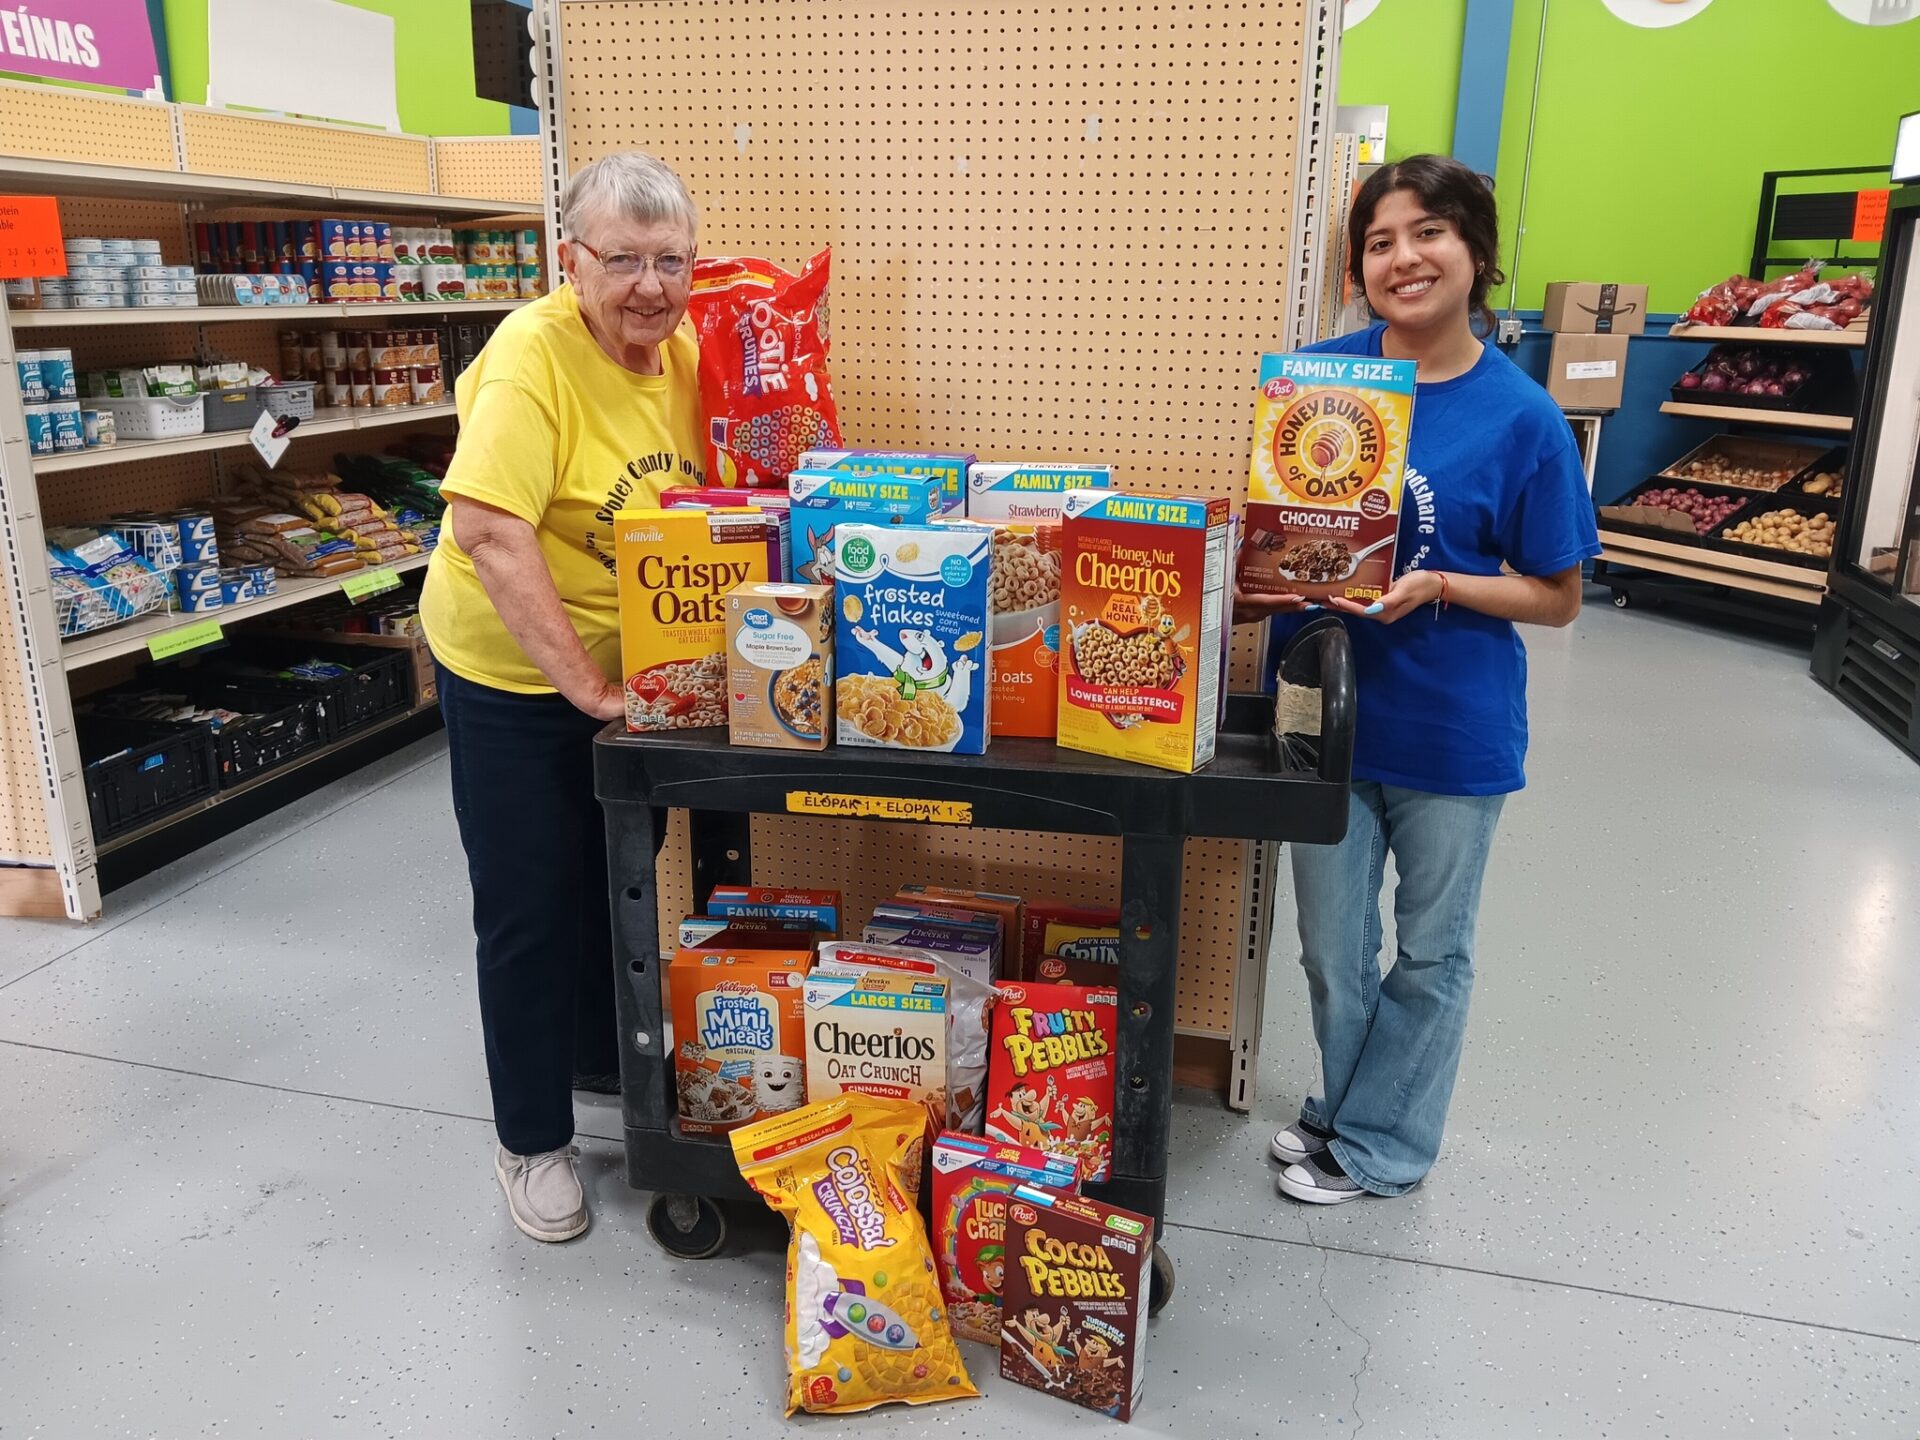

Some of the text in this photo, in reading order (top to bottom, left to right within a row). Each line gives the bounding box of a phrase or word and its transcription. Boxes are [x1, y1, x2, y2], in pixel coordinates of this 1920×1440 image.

[0, 5, 100, 68] EÍNAS
[1282, 360, 1394, 380] FAMILY SIZE
[1267, 381, 1291, 396] Post
[1280, 397, 1377, 463] HONEY BUNCHES
[1289, 466, 1306, 481] of
[1014, 474, 1093, 490] FAMILY SIZE
[1305, 470, 1363, 497] OATS
[829, 481, 908, 500] FAMILY SIZE
[889, 504, 898, 512] 12
[1008, 504, 1061, 519] Strawberry
[1106, 500, 1188, 523] FAMILY SIZE
[1208, 511, 1228, 526] Cheerios
[1279, 510, 1360, 530] CHOCOLATE
[712, 525, 721, 534] NO
[624, 532, 664, 543] Millville
[847, 543, 869, 554] food
[1112, 545, 1148, 566] Honey
[1152, 549, 1175, 566] Nut
[849, 554, 868, 564] club
[637, 555, 751, 595] Crispy
[1076, 552, 1181, 597] Cheerios
[732, 598, 739, 608] 8
[864, 584, 945, 608] frosted
[652, 591, 725, 624] Oats
[870, 604, 934, 626] flakes
[1112, 603, 1137, 614] REAL
[747, 612, 768, 621] Great
[935, 609, 981, 625] sweetened
[939, 618, 958, 628] corn
[1106, 611, 1142, 625] HONEY
[662, 627, 726, 638] TOASTED WHOLE GRAIN
[752, 632, 794, 641] Sugar Free
[935, 625, 961, 636] cereal
[679, 635, 711, 644] OAT CEREAL
[746, 643, 765, 651] Maple
[1002, 670, 1033, 684] oats
[1003, 694, 1025, 704] honey
[1071, 687, 1177, 711] LOWER CHOLESTEROL
[1120, 688, 1139, 696] HELP
[804, 796, 858, 809] ELOPAK
[886, 802, 941, 815] ELOPAK
[948, 806, 953, 816] 1
[726, 907, 818, 918] FAMILY SIZE
[729, 922, 768, 930] Cheerios
[1032, 919, 1039, 929] 8
[911, 928, 950, 940] Cheerios
[1043, 961, 1063, 974] Post
[715, 981, 758, 996] Kellogg's
[1003, 988, 1023, 999] Post
[715, 998, 757, 1010] Frosted
[851, 993, 932, 1011] LARGE SIZE
[708, 1010, 766, 1031] Mini
[1010, 1007, 1096, 1036] FRUITY
[704, 1027, 771, 1048] Wheats
[813, 1021, 936, 1062] Cheerios
[1004, 1030, 1108, 1077] PEBBLES
[827, 1058, 922, 1086] OAT CRUNCH
[848, 1085, 902, 1097] CINNAMON
[800, 1125, 836, 1144] RESEALABLE
[1045, 1175, 1054, 1184] 12
[826, 1145, 898, 1251] Colossal
[817, 1181, 852, 1241] CRUNCH
[974, 1198, 1007, 1220] Luc
[1014, 1207, 1034, 1220] Post
[1025, 1228, 1113, 1272] COCOA
[1019, 1256, 1126, 1298] PEBBLES
[1085, 1314, 1126, 1340] TURNS MILK
